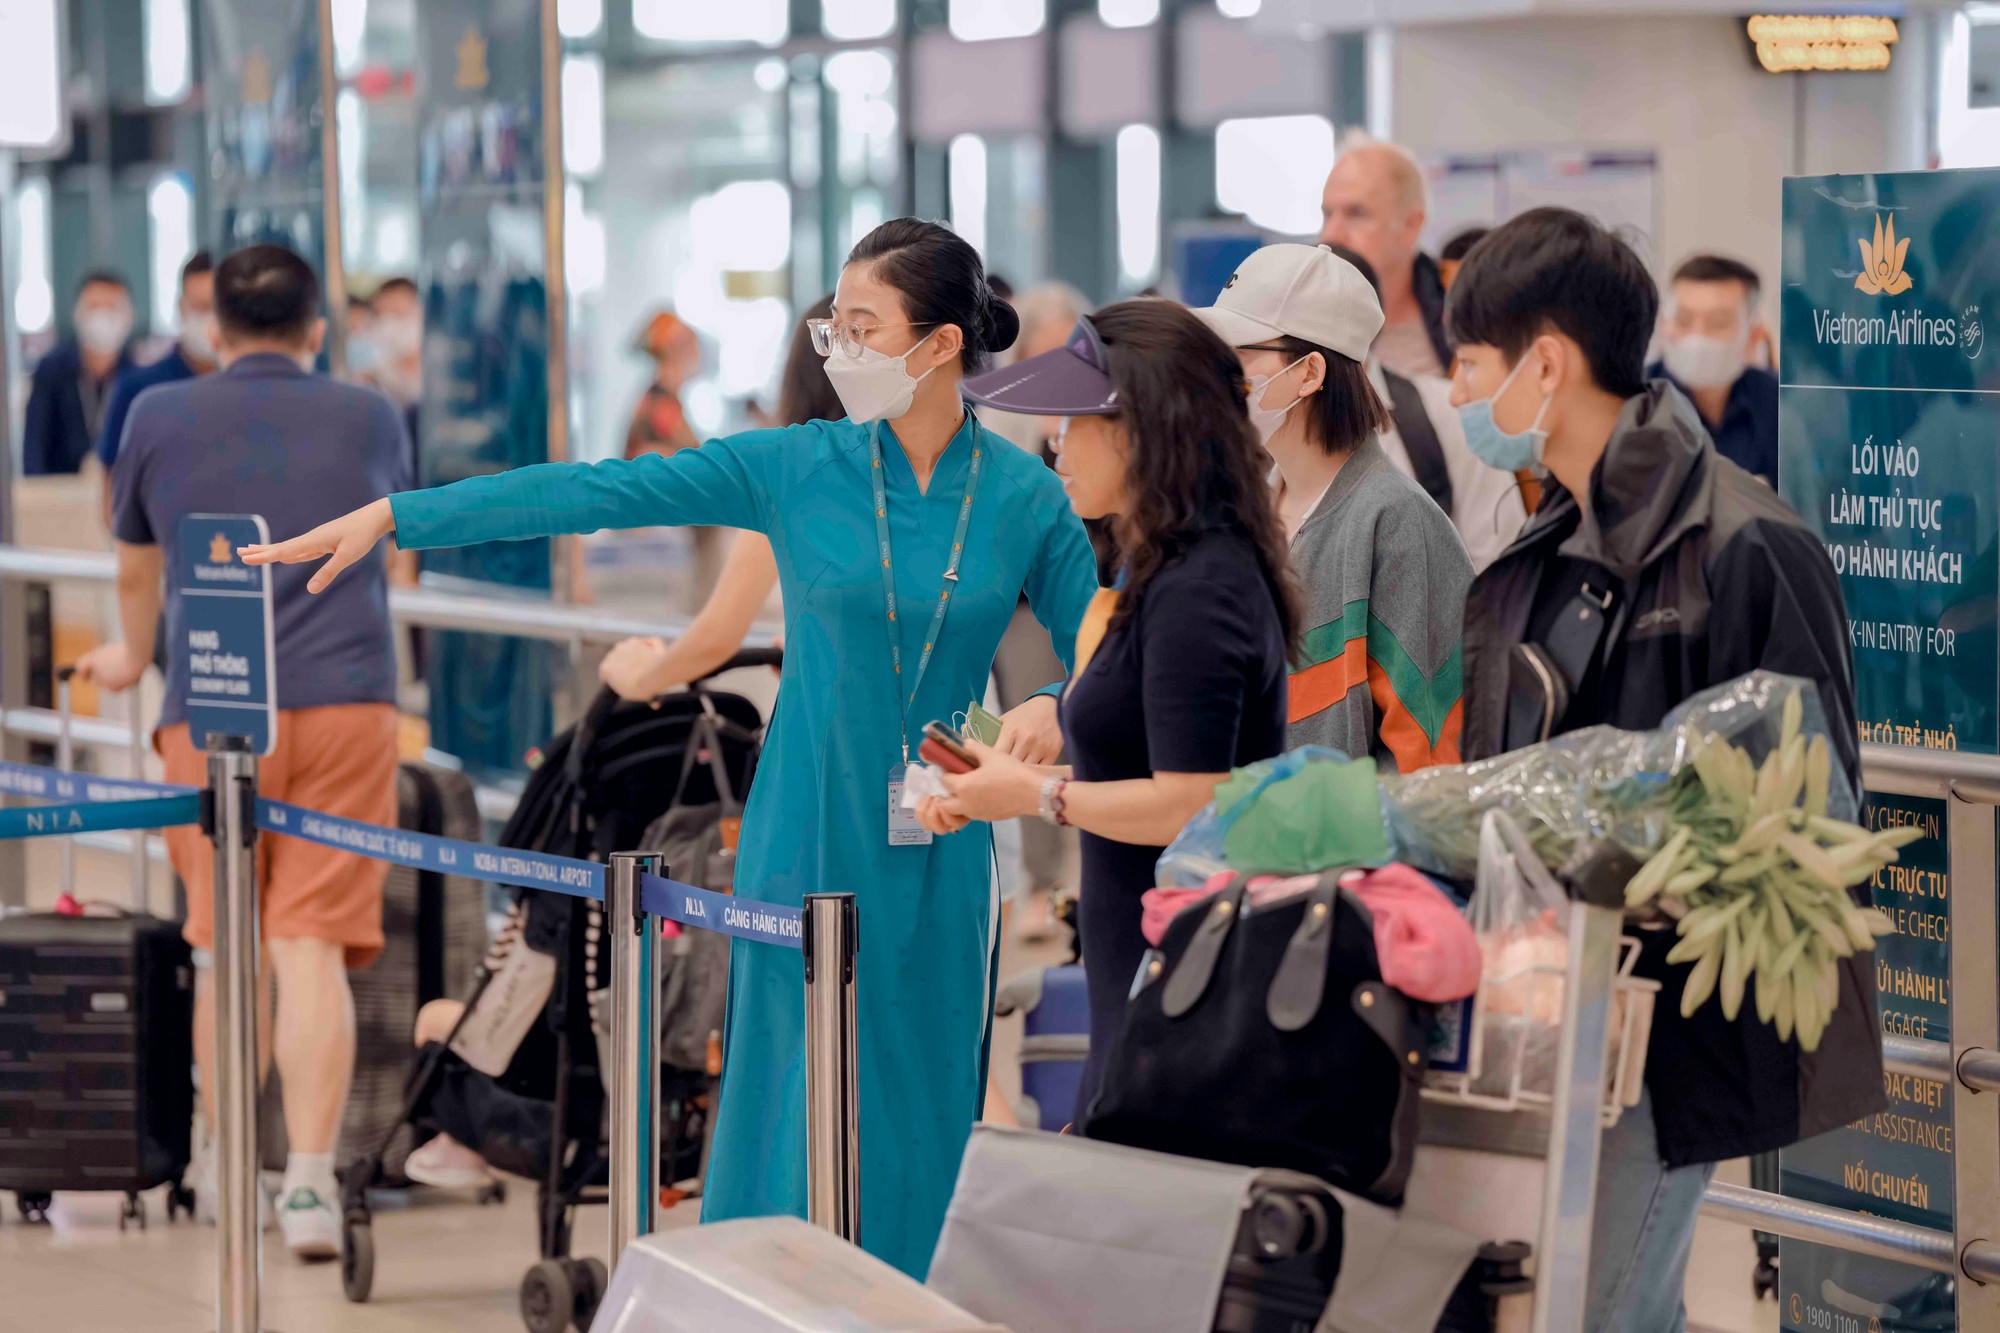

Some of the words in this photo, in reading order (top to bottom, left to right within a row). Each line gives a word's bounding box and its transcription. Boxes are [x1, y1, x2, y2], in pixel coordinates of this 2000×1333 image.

[1812, 309, 1886, 345] Vietnam
[1886, 309, 1956, 346] Airlines
[1852, 434, 1878, 475] LỐI
[1882, 439, 1920, 477] VÀO
[1830, 488, 1865, 525] LÀM
[1869, 488, 1903, 528] THỦ
[1908, 498, 1942, 538] TỤC
[1849, 540, 1898, 579] HÀNH
[1902, 545, 1962, 584] KHÁCH
[1879, 623, 1924, 653] ENTRY
[1926, 628, 1956, 657] FOR
[1873, 718, 1893, 745] CÓ
[1895, 719, 1921, 747] TRẺ
[1924, 723, 1957, 751] NHỎ
[559, 868, 593, 889] AIRPORT
[1888, 865, 1926, 902] TRỰC
[685, 896, 706, 918] N.I.A
[724, 901, 750, 930] CẢNG
[752, 909, 777, 934] HÀNG
[1895, 966, 1936, 1002] HÀNH
[1874, 1112, 1952, 1153] ASSISTANCE
[1844, 1160, 1868, 1194] NỐI
[1871, 1173, 1929, 1210] CHUYẾN
[1806, 1304, 1831, 1331] 1900
